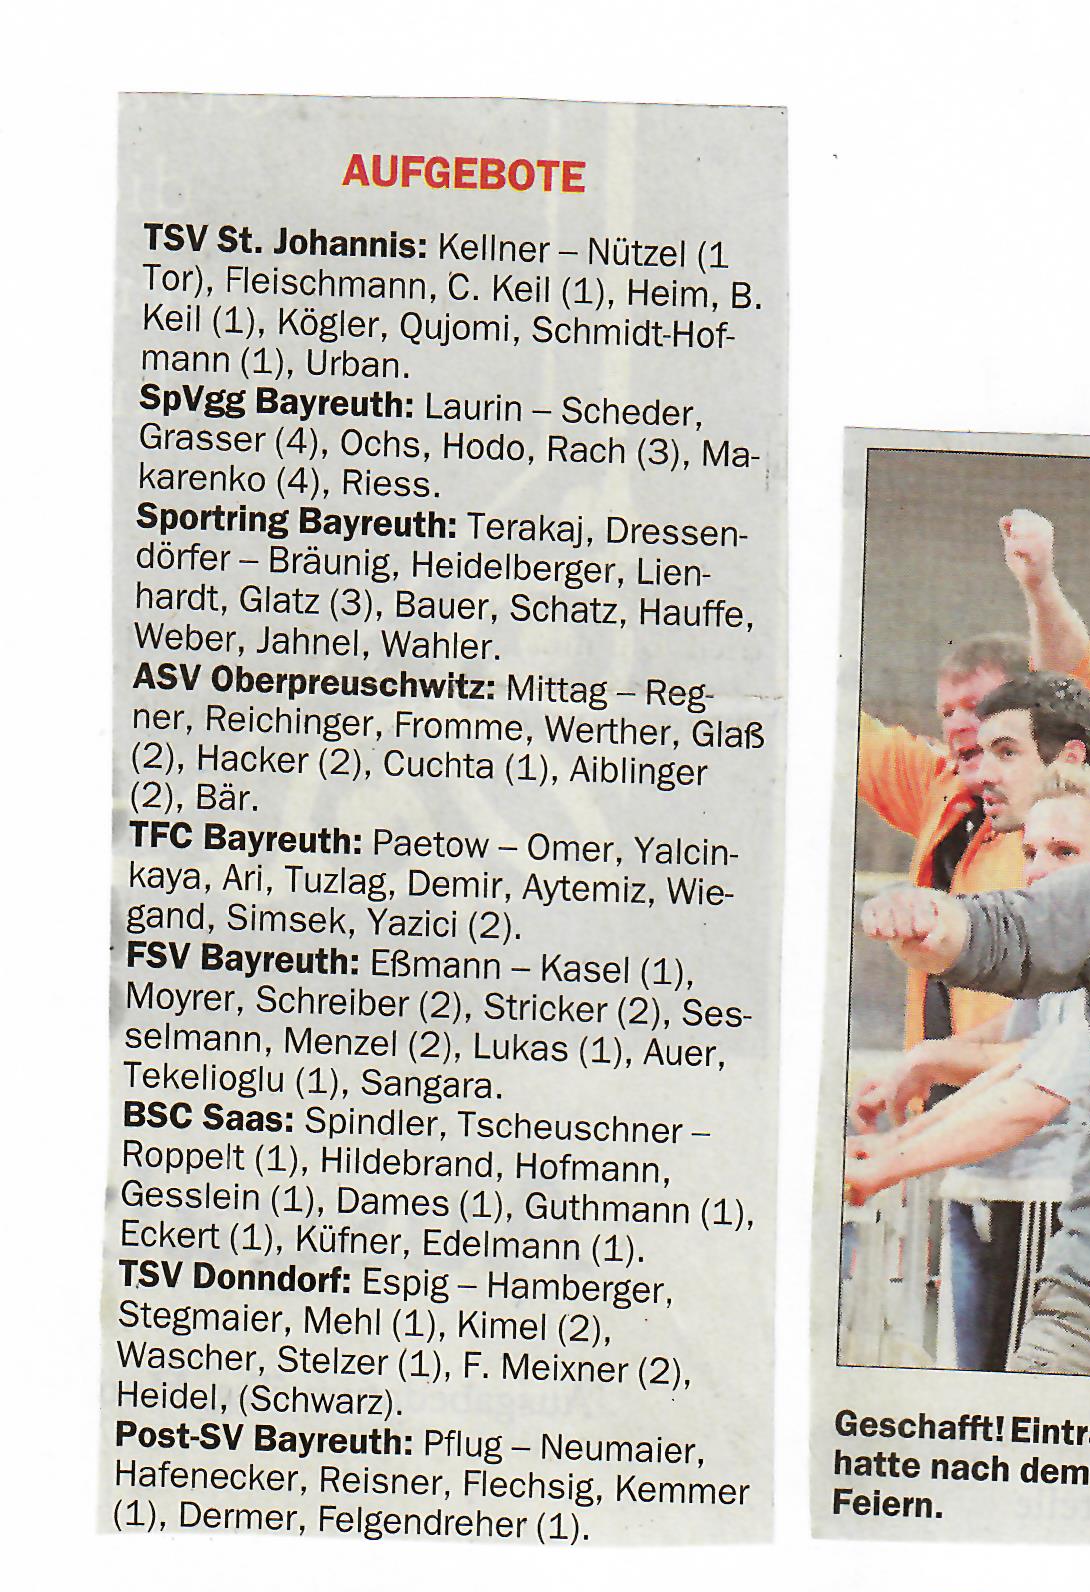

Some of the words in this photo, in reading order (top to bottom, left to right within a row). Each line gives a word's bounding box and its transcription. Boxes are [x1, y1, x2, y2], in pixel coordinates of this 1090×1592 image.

[341, 153, 587, 193] AUFGEBOTE
[142, 301, 202, 333] Keil
[212, 304, 266, 341] (1),
[277, 306, 388, 345] Kögler,
[399, 310, 521, 348] Qujomi,
[530, 314, 737, 350] Schmidt-Hof-
[141, 348, 231, 374] mann
[240, 345, 294, 382] (1),
[306, 347, 410, 380] Urban.
[135, 500, 291, 541] Sportring
[298, 505, 457, 543] Bayreuth:
[465, 510, 594, 550] Terakaj,
[606, 515, 749, 548] Dressen-
[133, 620, 246, 658] Weber,
[255, 624, 370, 662] Jahnel,
[380, 628, 501, 662] Wahler.
[132, 707, 194, 737] ner,
[205, 703, 383, 744] Reichinger,
[395, 709, 534, 747] Fromme,
[543, 714, 680, 752] Werther,
[691, 718, 766, 751] Glaß
[128, 819, 194, 850] TFC
[203, 821, 363, 859] Bayreuth:
[373, 827, 491, 860] Paetow
[526, 831, 623, 868] Omer,
[633, 835, 740, 867] Yalcin-
[125, 901, 215, 936] gand,
[226, 902, 356, 941] Simsek,
[366, 906, 458, 939] Yazici
[467, 910, 522, 947] (2).
[124, 1021, 273, 1058] selmann,
[284, 1025, 398, 1058] Menzel
[408, 1029, 462, 1066] (2),
[473, 1031, 569, 1063] Lukas
[578, 1034, 633, 1071] (1),
[642, 1036, 726, 1073] Auer,
[122, 1059, 285, 1100] Tekelioglu
[295, 1065, 349, 1102] (1),
[360, 1067, 503, 1106] Sangara.
[122, 1138, 246, 1176] Roppelt
[254, 1143, 309, 1179] (1),
[320, 1145, 504, 1184] Hildebrand,
[515, 1151, 671, 1190] Hofmann,
[120, 1218, 222, 1251] Eckert
[229, 1221, 283, 1258] (1),
[295, 1223, 411, 1261] Küfner,
[422, 1227, 581, 1262] Edelmann
[591, 1232, 645, 1270] (1).
[117, 1379, 228, 1416] Heidel,
[238, 1383, 403, 1423] (Schwarz).
[834, 1408, 1006, 1443] Geschafft!
[115, 1458, 308, 1497] Hafenecker,
[319, 1464, 451, 1502] Reisner,
[463, 1468, 603, 1509] Flechsig,
[615, 1473, 752, 1506] Kemmer
[833, 1448, 922, 1480] hatte
[930, 1453, 1010, 1483] nach
[1019, 1455, 1090, 1487] dem
[113, 1498, 167, 1534] (1),
[179, 1500, 306, 1537] Dermer,
[318, 1504, 529, 1542] Felgendreher
[536, 1511, 590, 1547] (1).
[832, 1486, 944, 1520] Feiern.
